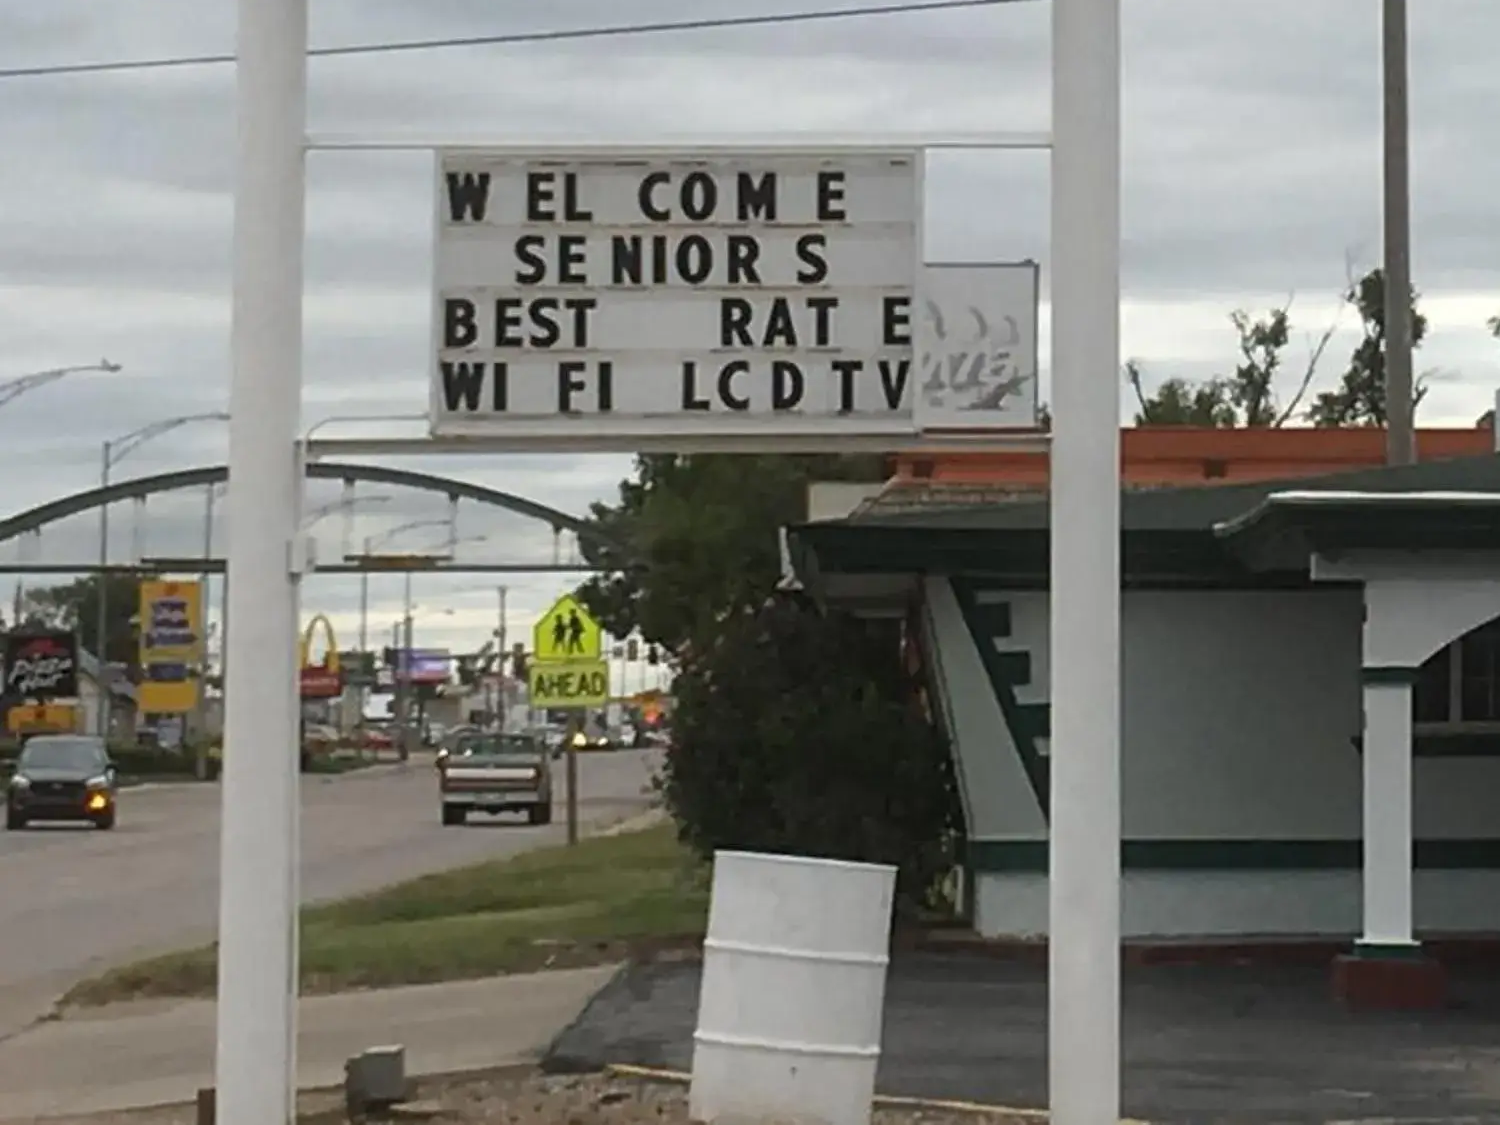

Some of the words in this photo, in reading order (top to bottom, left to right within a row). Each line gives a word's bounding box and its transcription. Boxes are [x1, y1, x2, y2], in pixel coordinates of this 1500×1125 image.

[514, 233, 829, 285] SENIORS
[443, 297, 598, 349] BEST
[720, 297, 913, 348] RATE
[534, 672, 605, 698] AHEAD
